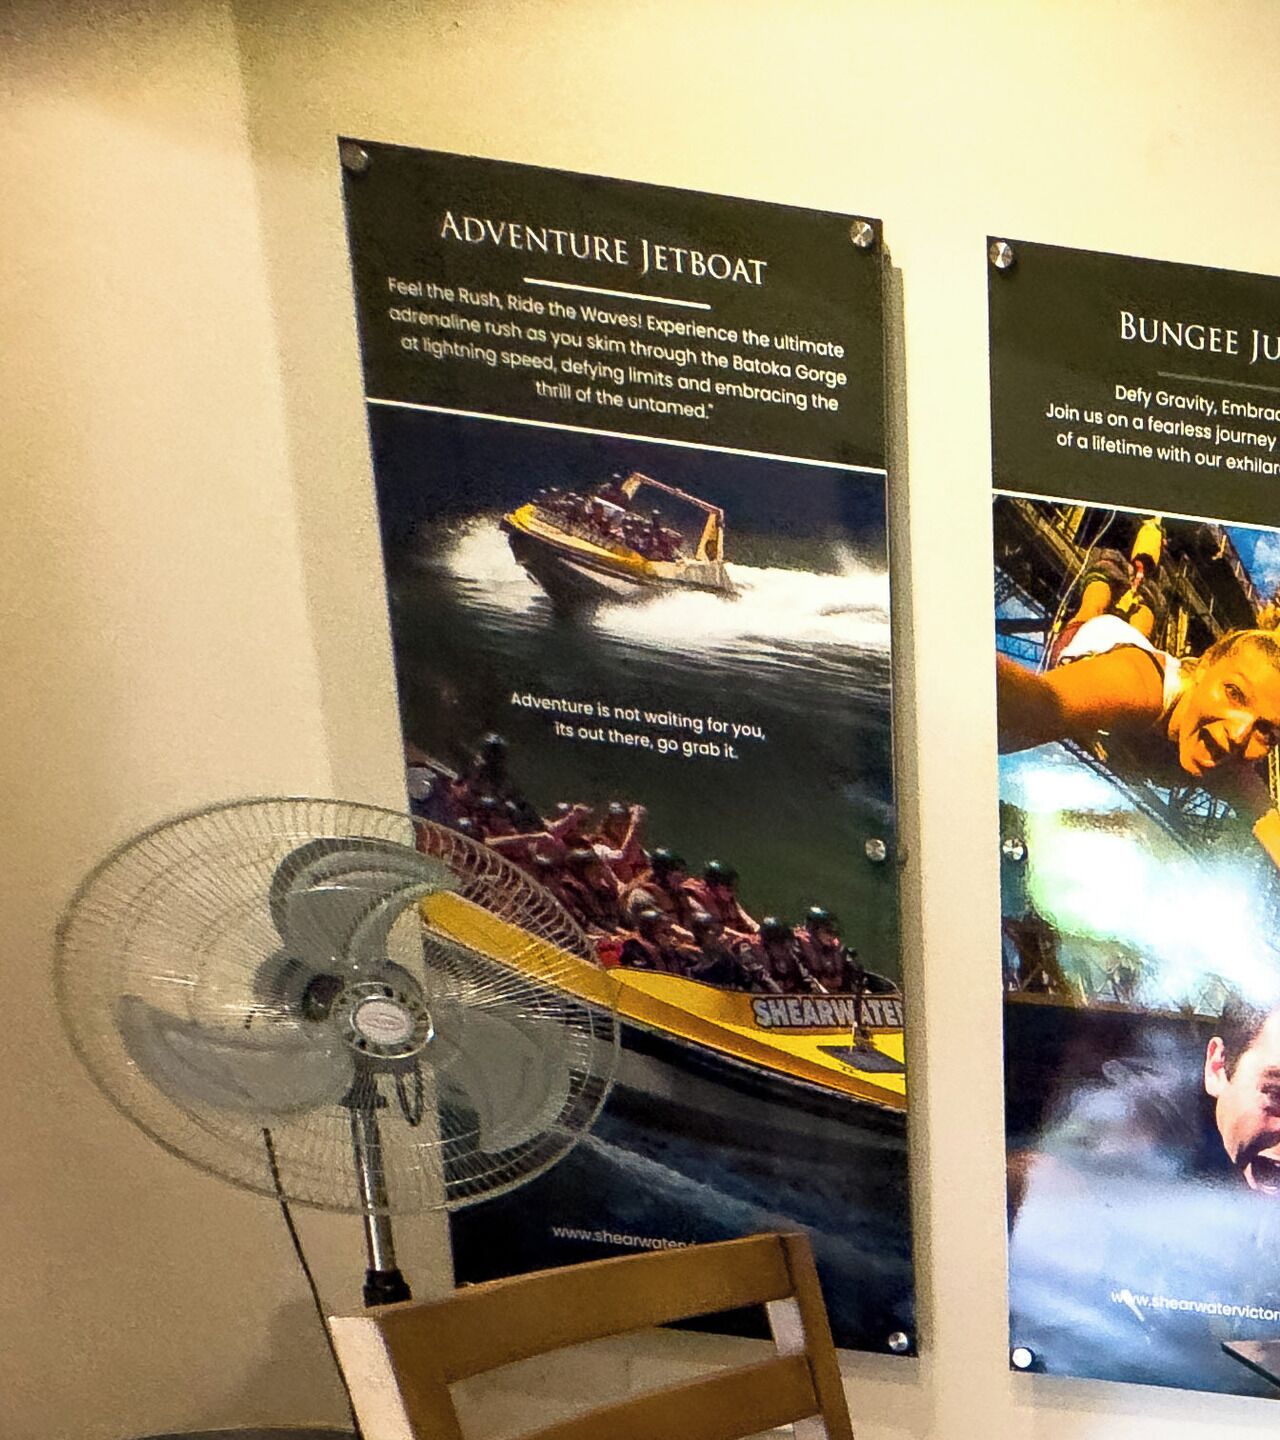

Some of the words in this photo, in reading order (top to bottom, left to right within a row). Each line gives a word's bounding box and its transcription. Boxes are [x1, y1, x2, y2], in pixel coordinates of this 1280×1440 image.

[400, 336, 419, 351] at
[422, 337, 497, 366] lightning
[500, 351, 557, 372] speed,
[560, 358, 624, 385] defying
[628, 366, 674, 387] limits
[677, 376, 711, 392] and
[714, 382, 808, 410] embracing
[811, 393, 839, 411] the
[1115, 384, 1152, 408] Defy
[1155, 391, 1217, 416] Gravity,
[1045, 403, 1080, 421] Join
[1083, 410, 1103, 424] us
[1106, 413, 1128, 428] on
[1132, 417, 1143, 430] a
[1147, 416, 1212, 439] fearless
[1214, 425, 1277, 451] journey
[1056, 431, 1073, 447] of
[1076, 436, 1088, 449] a
[1092, 435, 1153, 458] lifetime
[1156, 445, 1191, 463] with
[1194, 452, 1222, 467] our
[510, 692, 594, 715] Adventure
[596, 701, 611, 717] is
[613, 707, 641, 721] not
[643, 711, 703, 734] waiting
[706, 716, 729, 733] for
[731, 723, 765, 740] you,
[577, 727, 605, 741] out
[608, 729, 654, 749] there,
[656, 738, 678, 754] go
[682, 741, 720, 757] grab
